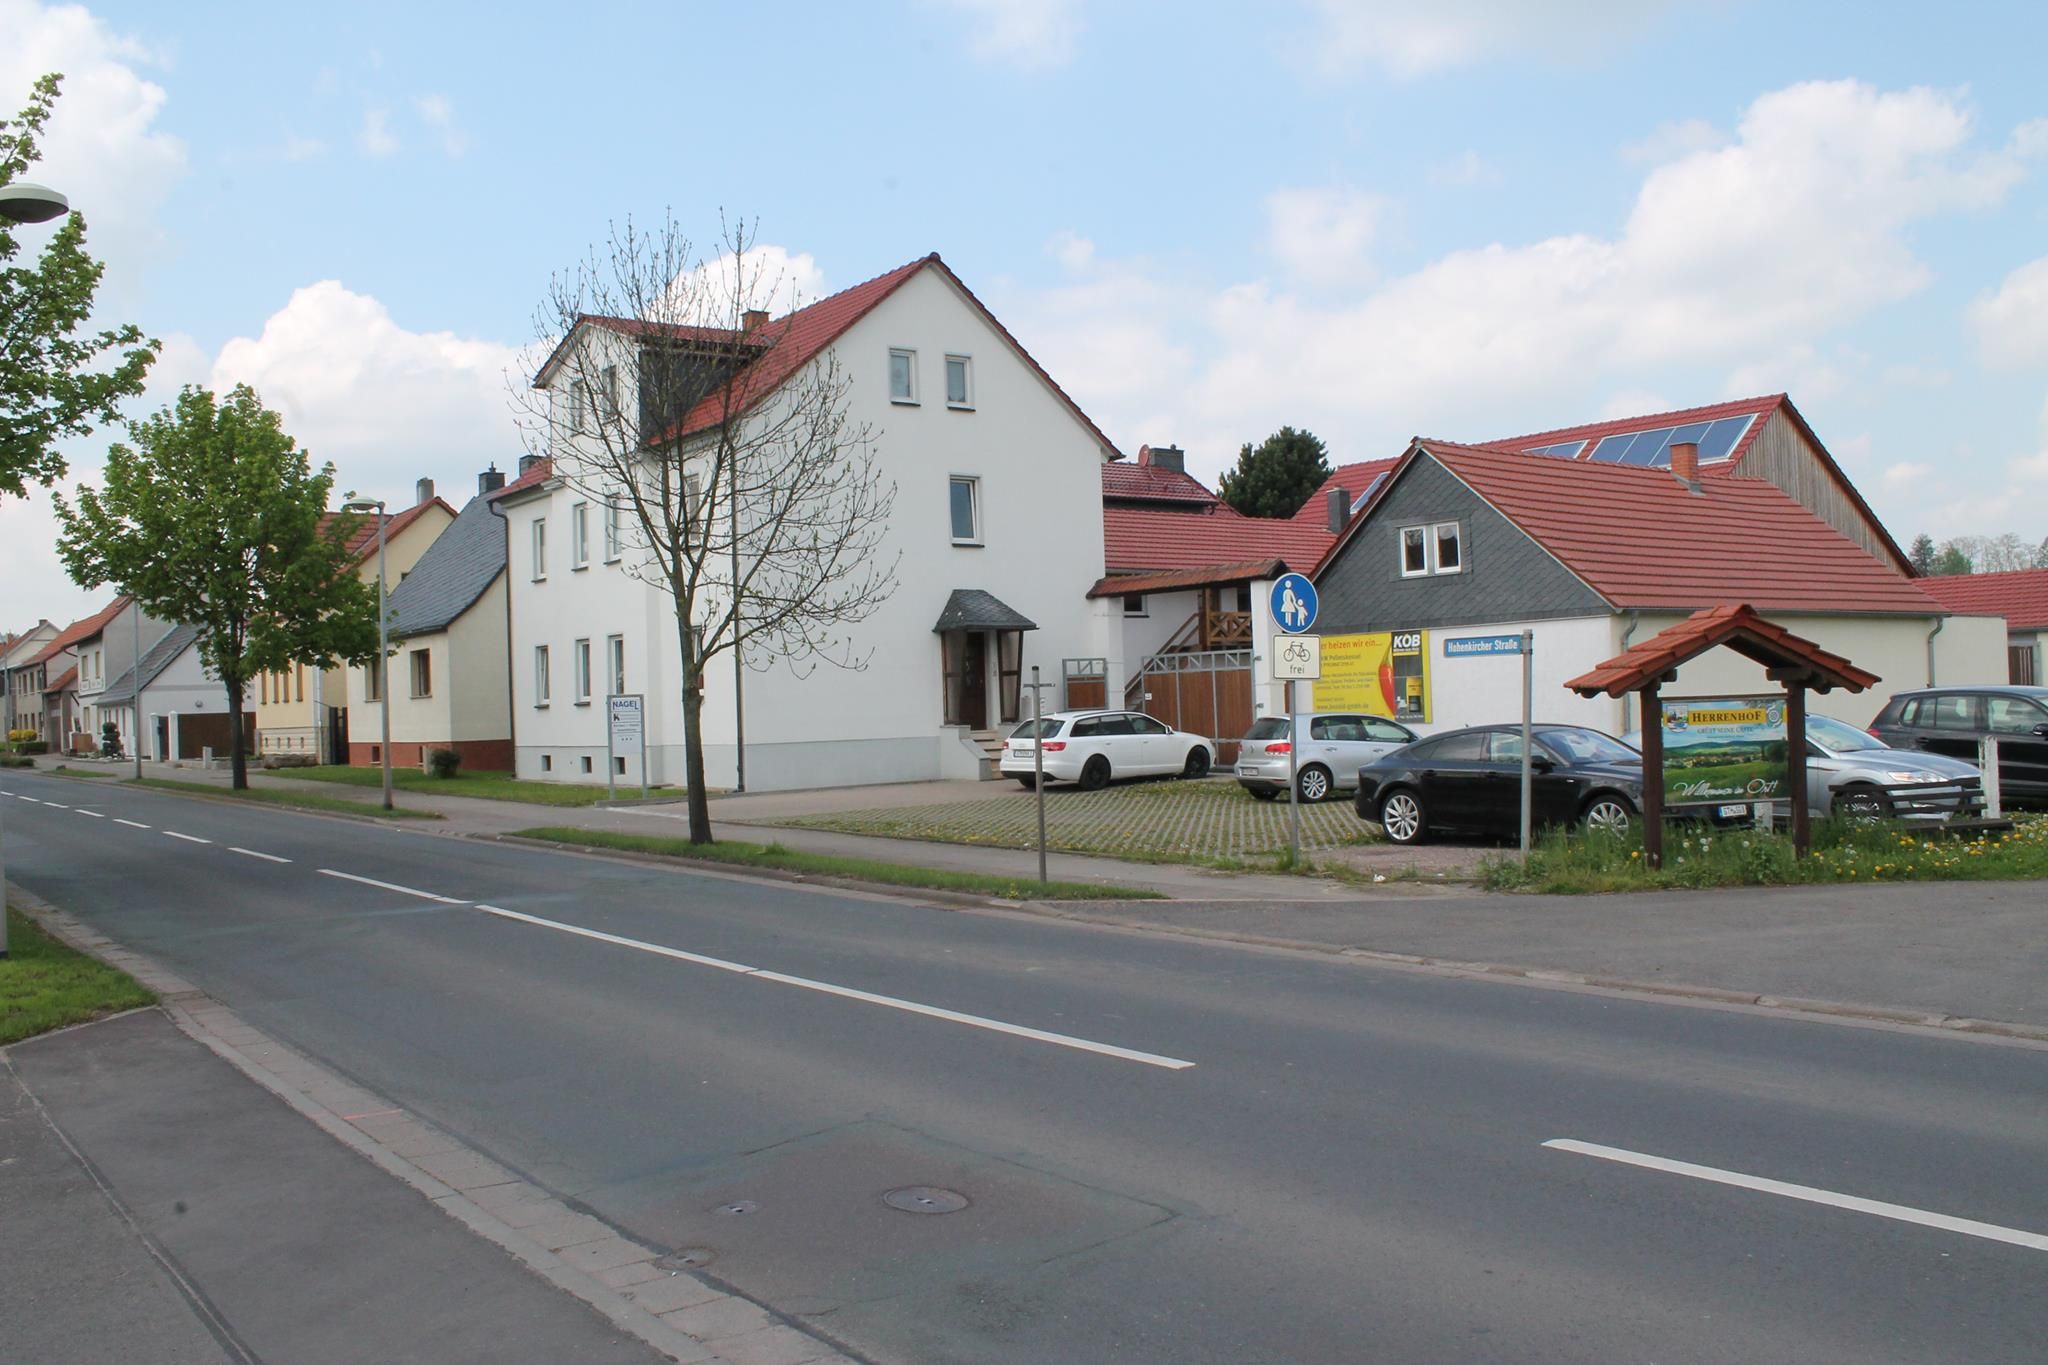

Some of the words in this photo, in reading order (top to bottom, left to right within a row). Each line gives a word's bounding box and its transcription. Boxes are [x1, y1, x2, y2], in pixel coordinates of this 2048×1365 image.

[1352, 640, 1363, 648] wir
[1447, 640, 1493, 652] Hohenkircher
[1494, 639, 1518, 650] Straße
[1290, 664, 1305, 675] frei
[612, 700, 639, 710] NAGEL
